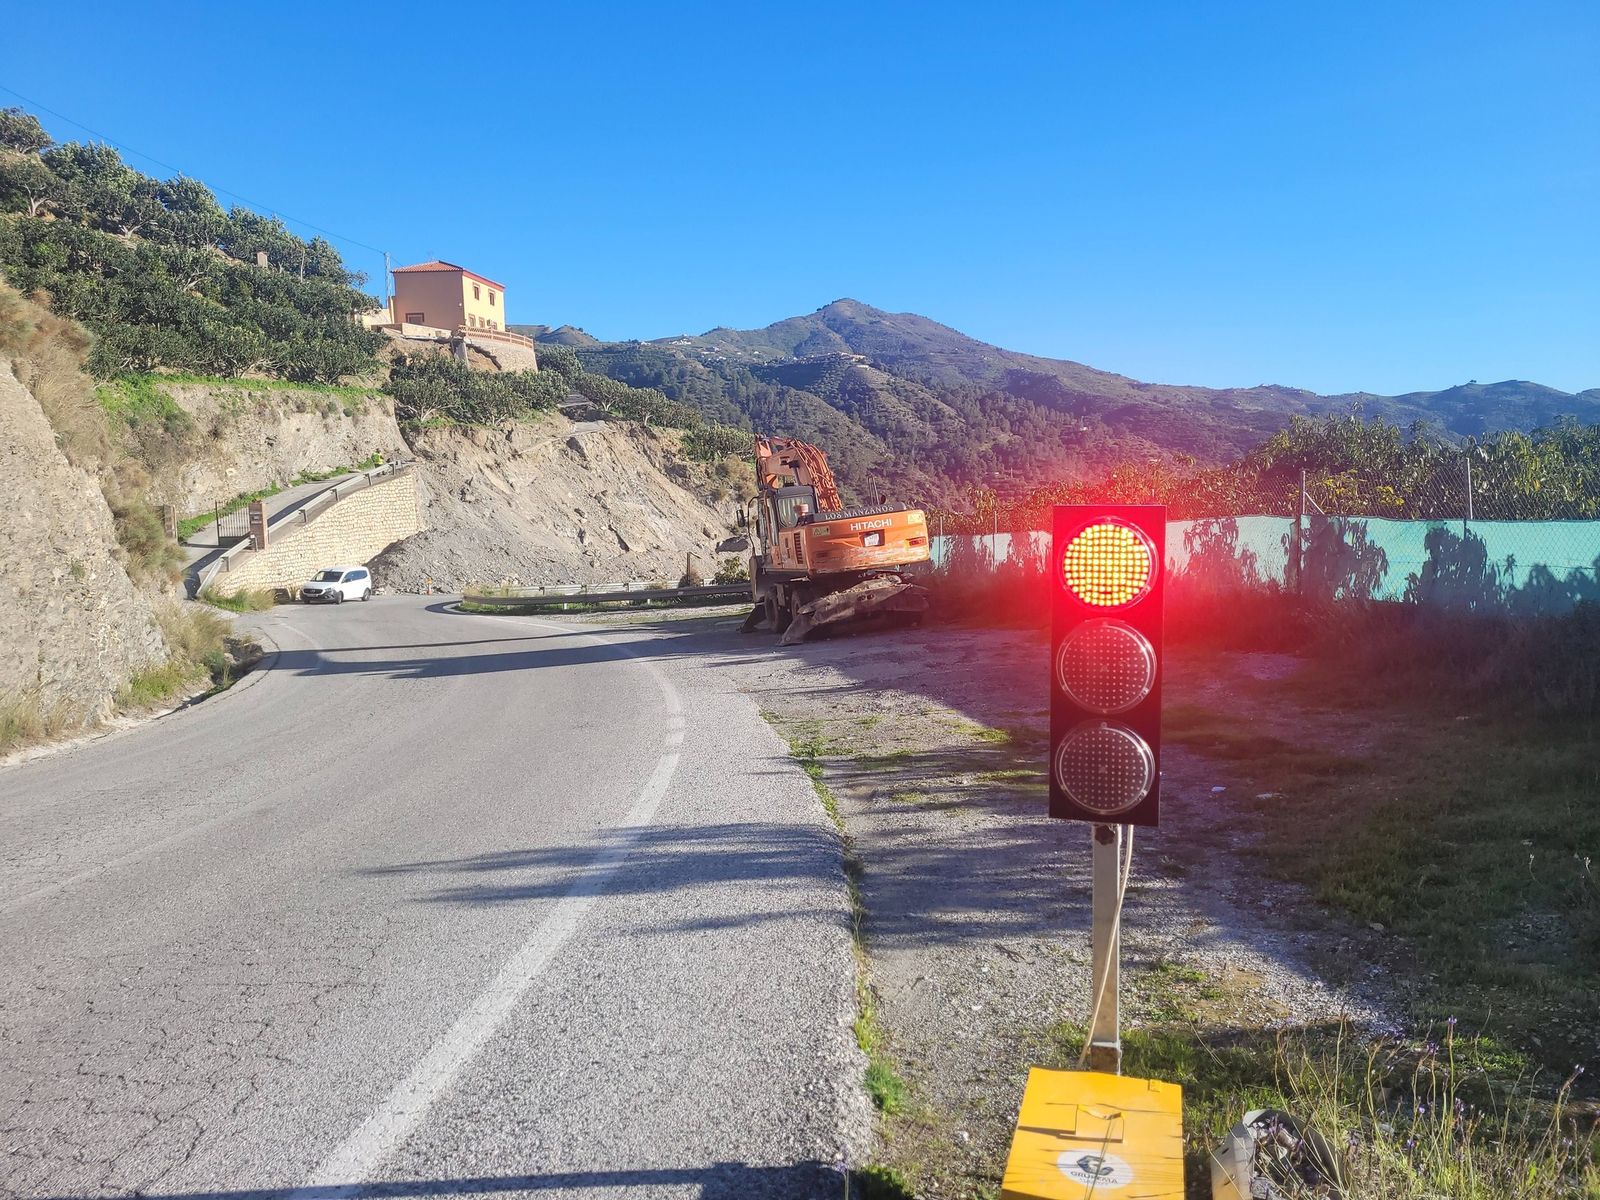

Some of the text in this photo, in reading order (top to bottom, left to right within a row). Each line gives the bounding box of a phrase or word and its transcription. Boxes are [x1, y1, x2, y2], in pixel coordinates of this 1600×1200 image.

[825, 504, 894, 520] LOS MANZANOS
[850, 518, 892, 531] HITACHI
